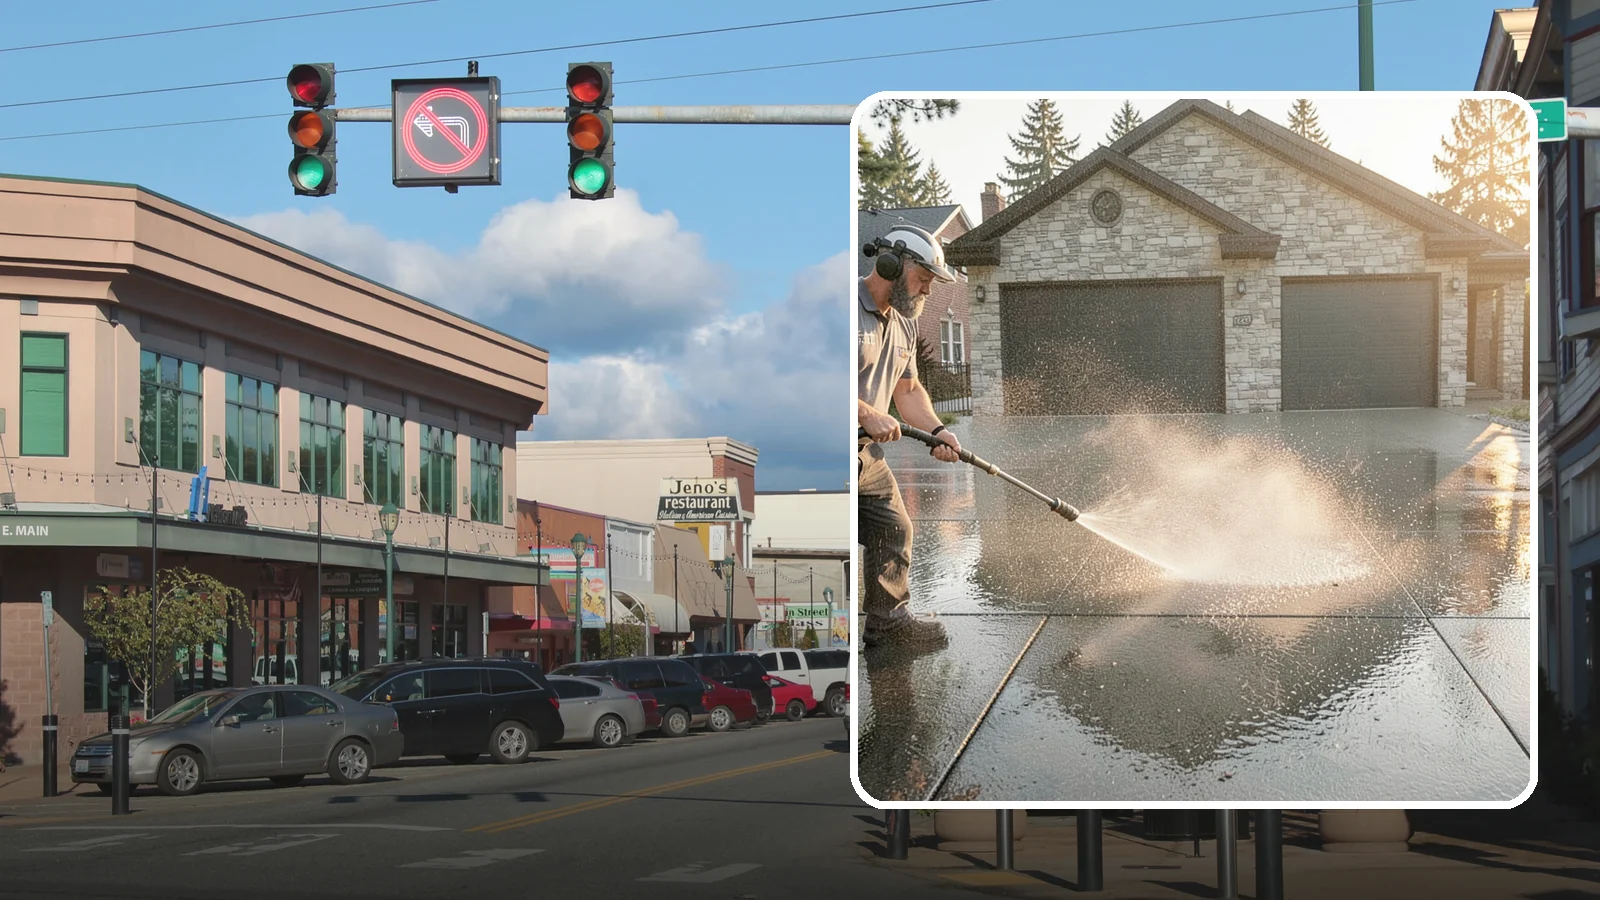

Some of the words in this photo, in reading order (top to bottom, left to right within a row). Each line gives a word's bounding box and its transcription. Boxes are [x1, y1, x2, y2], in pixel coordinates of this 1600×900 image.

[670, 480, 727, 494] Jeno's
[665, 496, 730, 508] restaurant
[658, 510, 681, 519] Italian
[686, 510, 714, 519] American
[714, 510, 738, 519] Cuisine
[2, 525, 12, 536] E.
[16, 525, 48, 536] MAIN
[798, 608, 829, 616] Street
